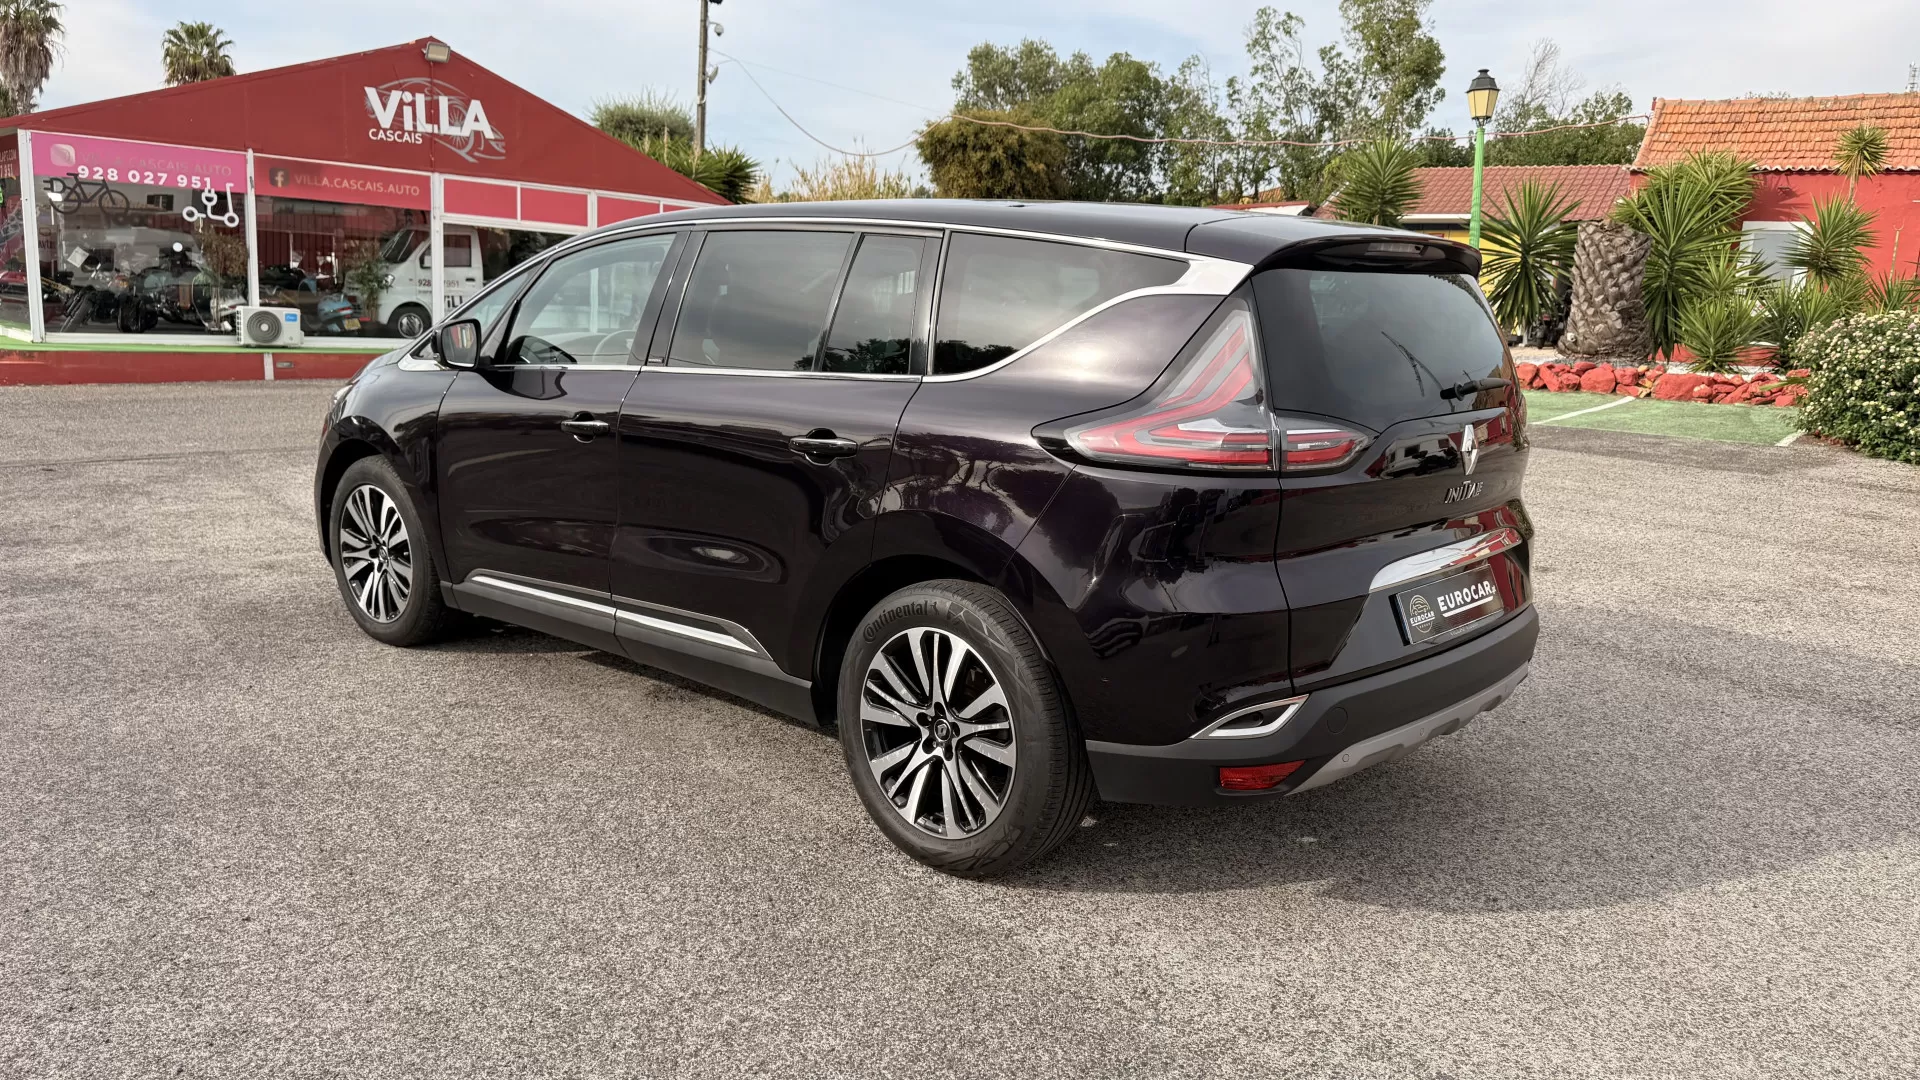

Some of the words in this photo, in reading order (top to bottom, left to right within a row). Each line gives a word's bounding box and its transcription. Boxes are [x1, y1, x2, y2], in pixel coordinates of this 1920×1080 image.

[368, 128, 423, 144] CASCAIS
[77, 165, 119, 181] 928
[128, 169, 168, 186] 027
[176, 174, 212, 190] 951
[294, 173, 420, 197] VILLA.CASCAIS.AUTO
[1437, 580, 1493, 612] EUROCAR
[862, 600, 928, 644] Continental
[1409, 611, 1435, 624] EUROCAR
